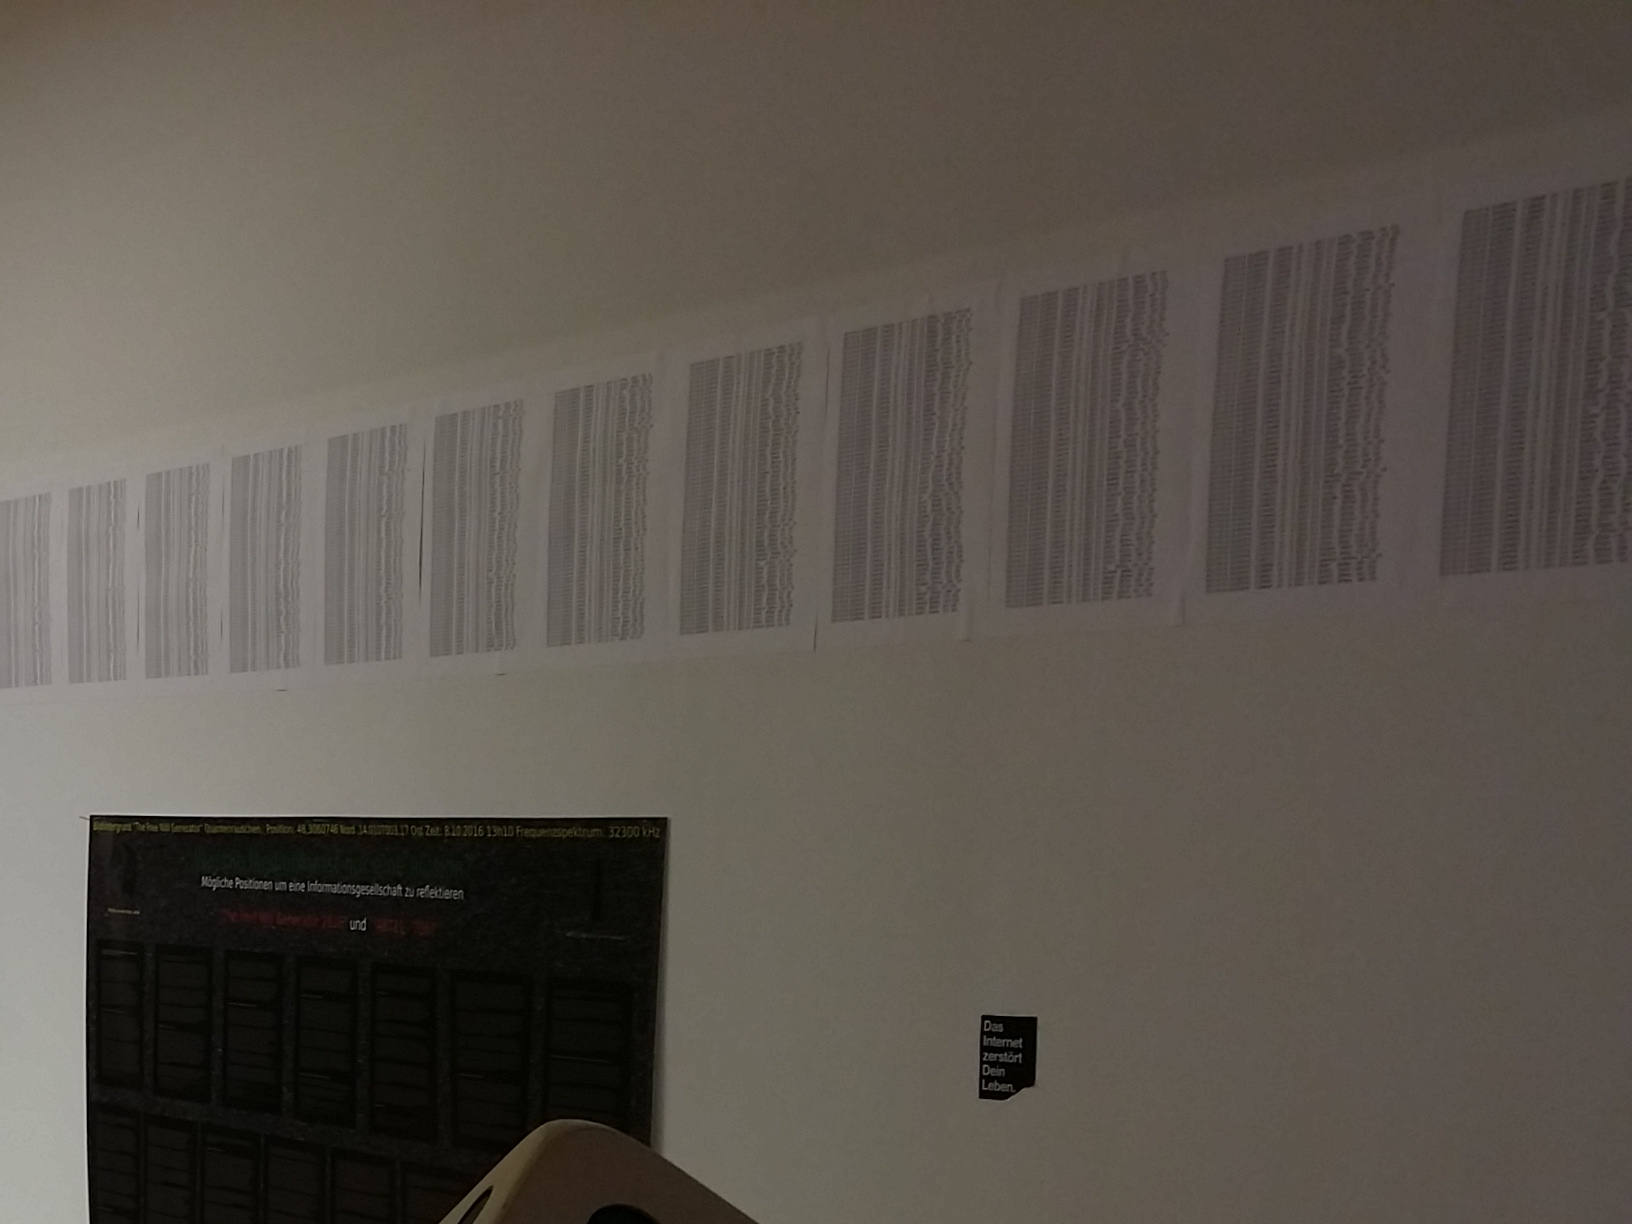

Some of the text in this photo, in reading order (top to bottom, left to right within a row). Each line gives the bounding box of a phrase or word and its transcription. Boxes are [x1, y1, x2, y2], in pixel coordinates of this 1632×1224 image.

[200, 875, 465, 901] Mögliche Positionen um eine Informationsgesellschaft zu reflektieren
[349, 918, 367, 931] und
[983, 1020, 1004, 1032] Das
[982, 1035, 1023, 1048] Internet
[982, 1051, 1023, 1064] zerstört
[981, 1064, 1006, 1077] Dein
[981, 1079, 1016, 1093] Leben.
